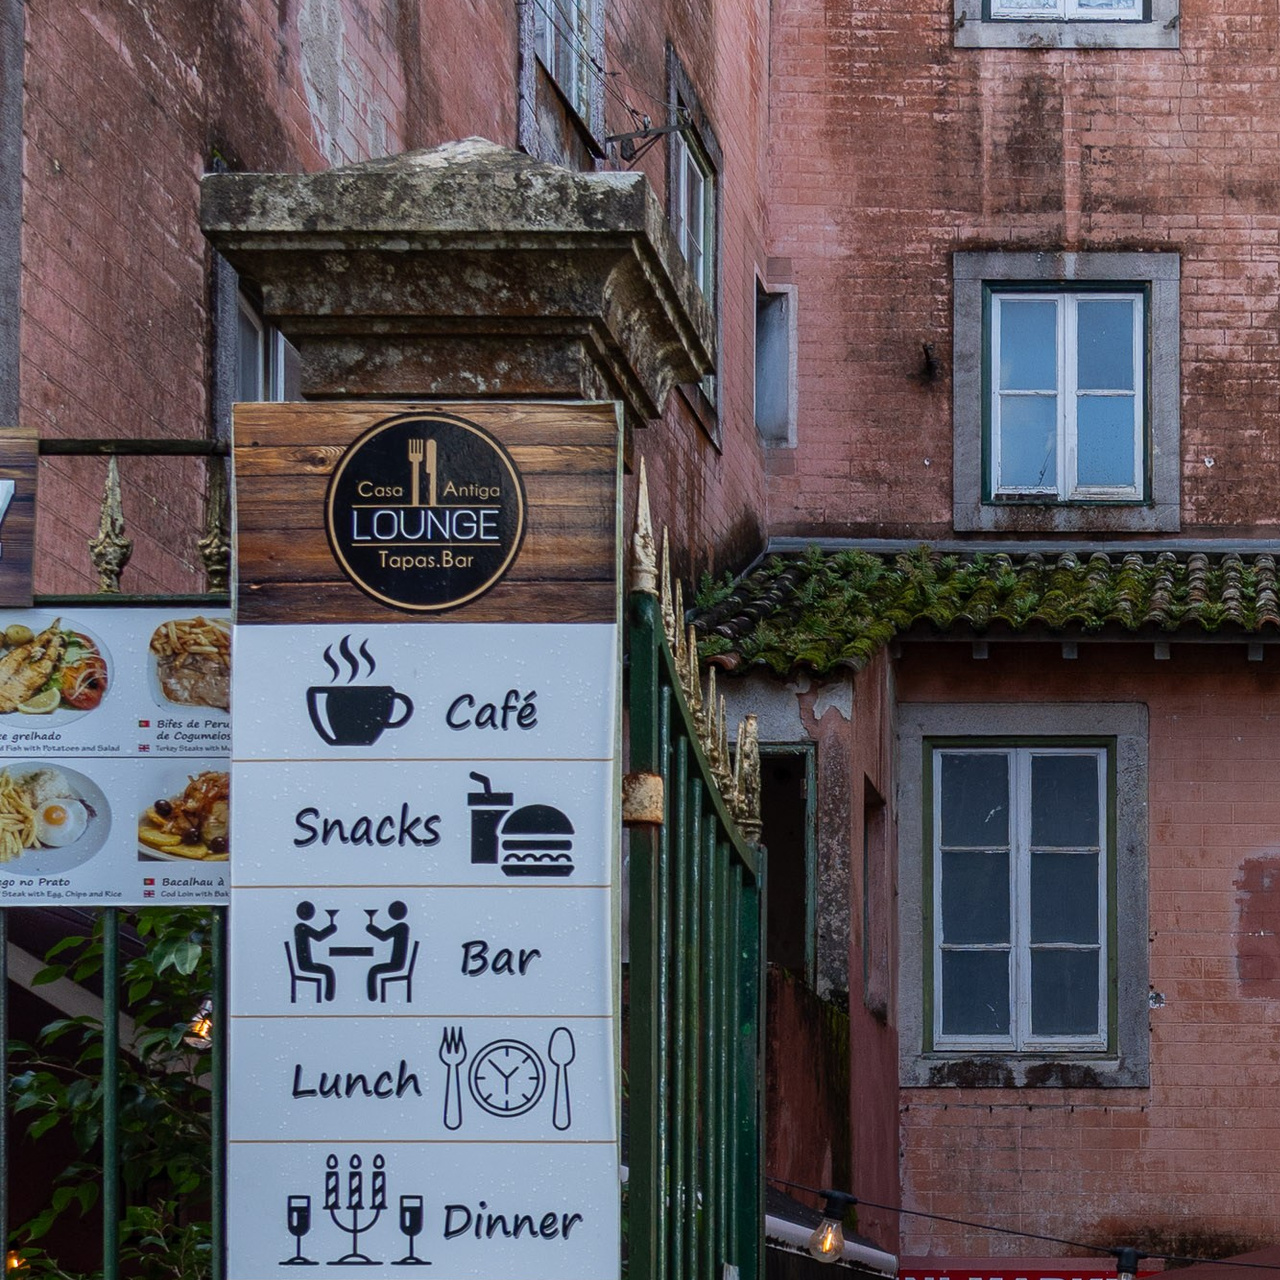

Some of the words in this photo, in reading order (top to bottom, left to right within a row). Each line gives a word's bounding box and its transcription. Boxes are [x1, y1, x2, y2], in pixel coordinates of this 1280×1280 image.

[357, 480, 404, 498] Casa
[443, 480, 500, 500] Antiga
[352, 509, 500, 540] LOUNGE
[378, 550, 474, 571] Tapas.Bar
[445, 688, 539, 731] Café
[157, 719, 184, 729] Bifes
[186, 719, 200, 729] de
[204, 719, 230, 729] Peru
[11, 731, 62, 743] grelhado
[156, 731, 170, 741] de
[24, 744, 42, 752] with
[42, 744, 81, 752] Potatoes
[81, 744, 97, 752] and
[97, 744, 121, 752] Salad
[292, 801, 443, 848] Snacks
[19, 879, 35, 887] no
[37, 877, 71, 887] Prato
[162, 877, 214, 887] Bacalhau
[217, 876, 225, 887] à
[1, 890, 27, 898] Steak
[65, 890, 88, 899] Chips
[88, 890, 104, 898] and
[104, 890, 123, 898] Rice
[160, 890, 176, 898] Cod
[194, 890, 213, 898] with
[461, 939, 541, 976] Bar
[292, 1059, 423, 1099] Lunch
[443, 1200, 583, 1240] Dinner
